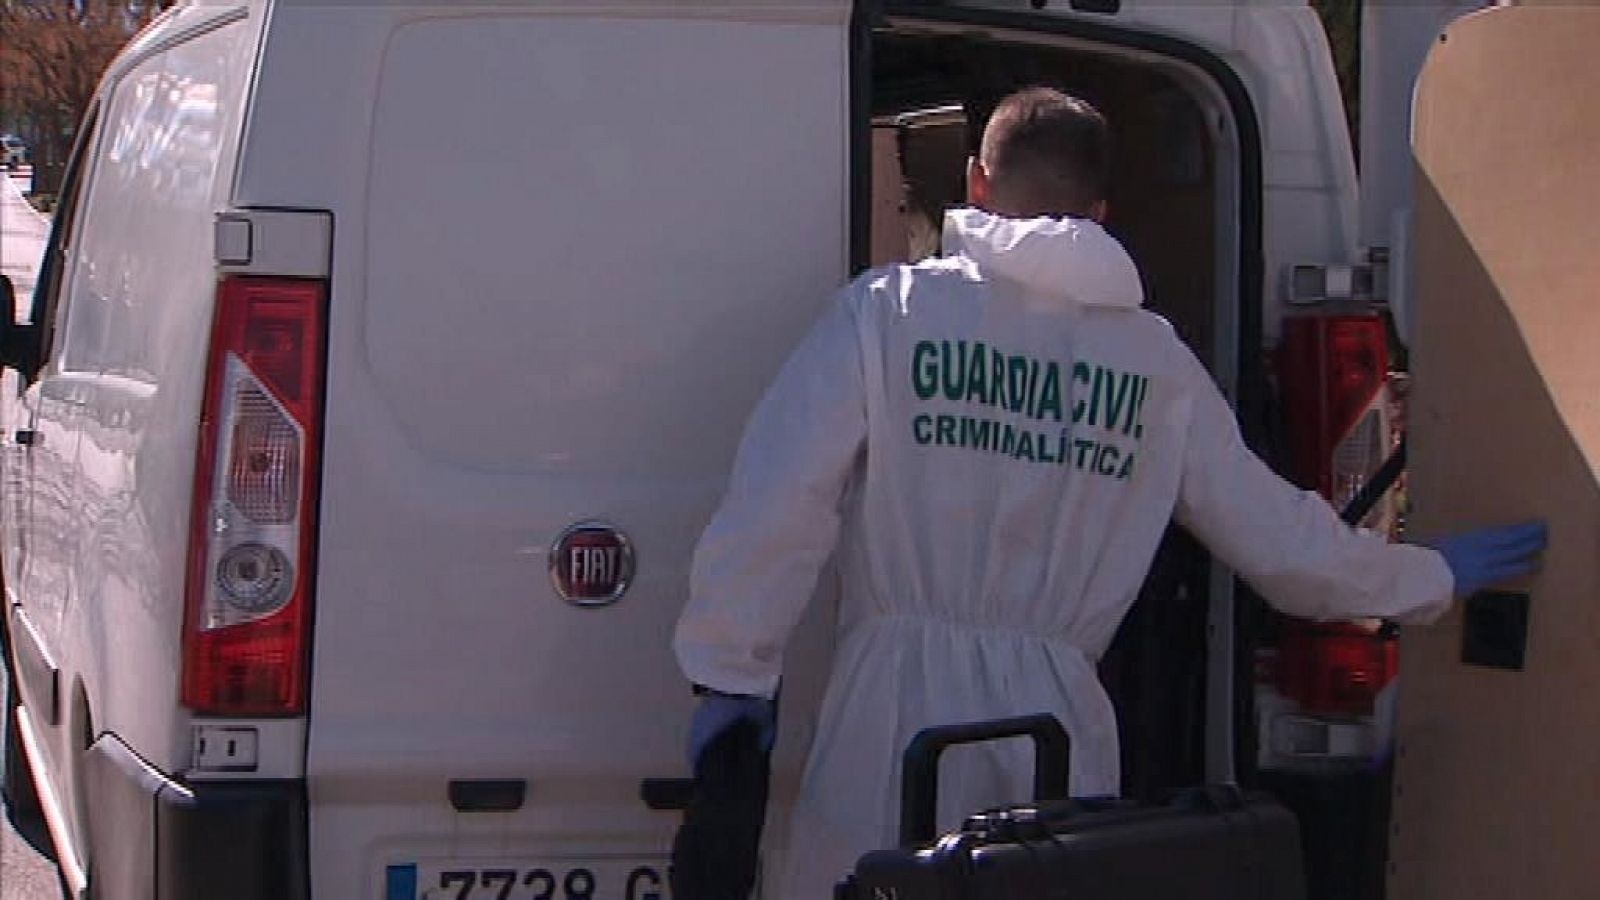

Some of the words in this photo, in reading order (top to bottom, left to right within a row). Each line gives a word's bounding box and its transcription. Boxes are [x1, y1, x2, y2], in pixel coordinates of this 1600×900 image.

[912, 340, 1062, 423] GUARDIA
[912, 415, 1134, 479] CRIMINALÍTICA
[571, 546, 617, 585] FIAT
